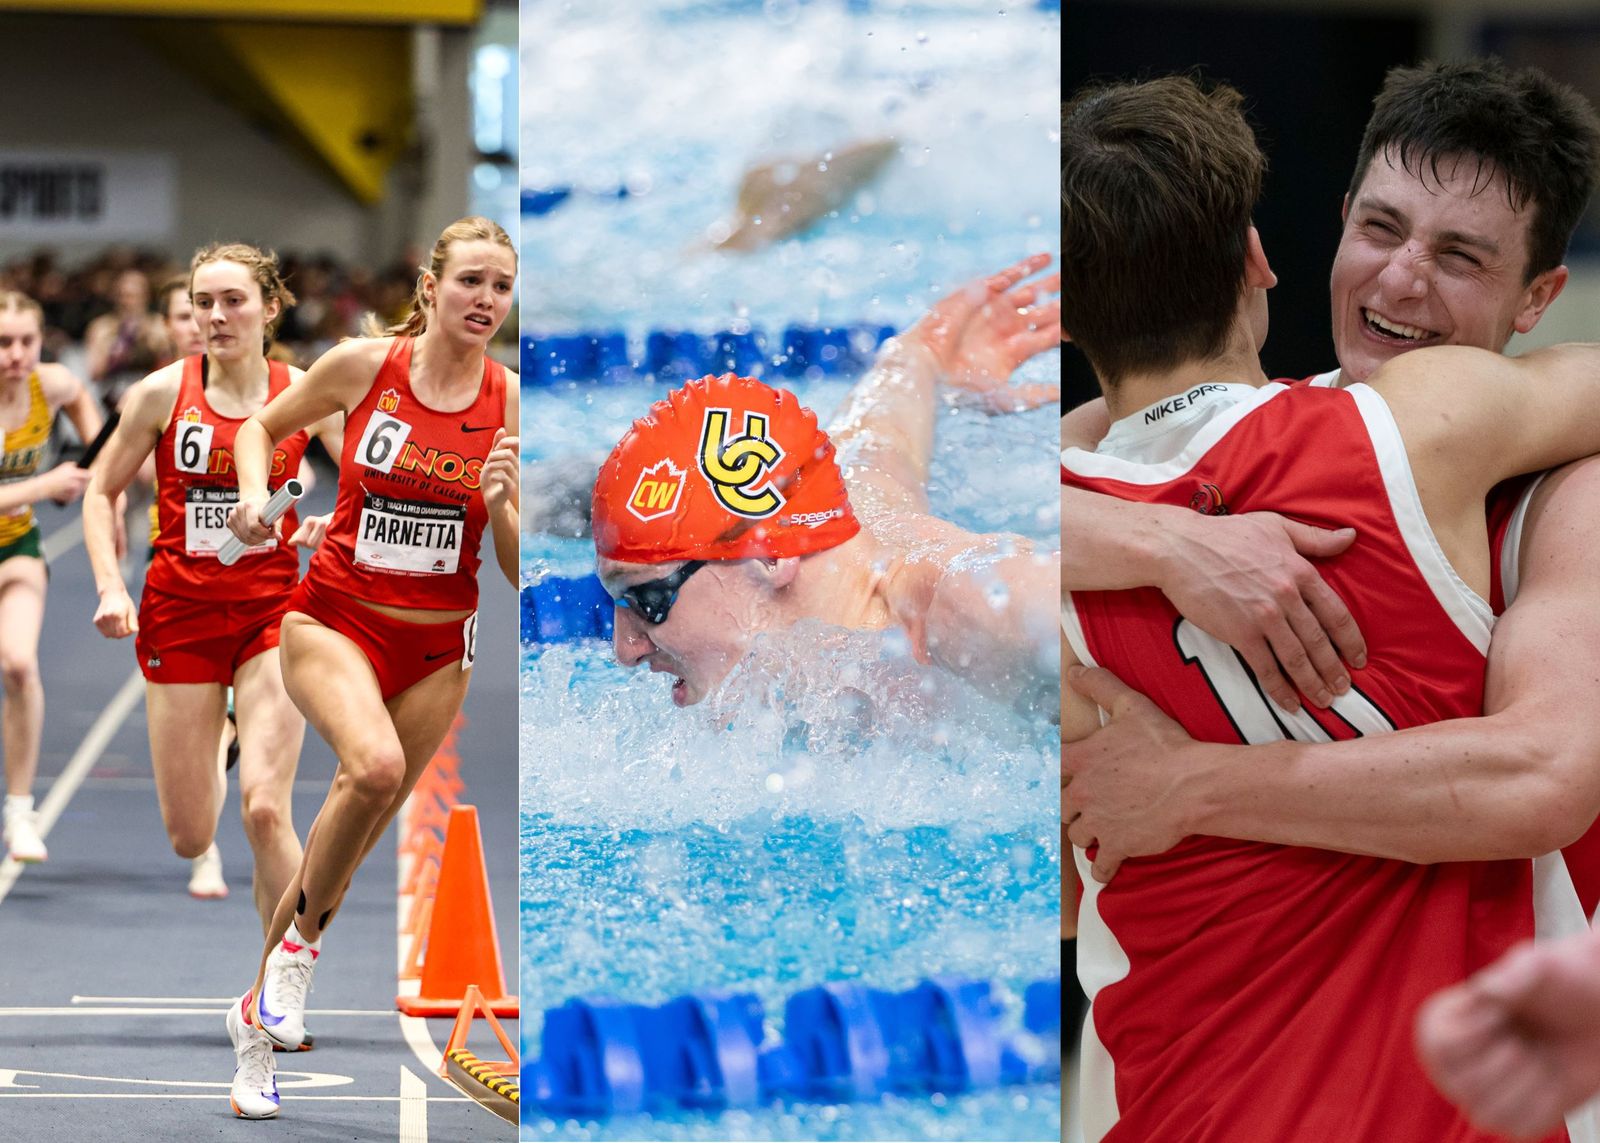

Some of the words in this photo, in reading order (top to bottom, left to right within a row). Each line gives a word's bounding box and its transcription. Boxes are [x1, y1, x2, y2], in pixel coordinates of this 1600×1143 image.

[379, 396, 398, 411] CW
[1144, 397, 1186, 425] NIKE
[1187, 384, 1228, 405] PRO
[180, 425, 204, 469] 6
[365, 419, 401, 466] 6
[392, 440, 485, 490] INOS
[364, 468, 417, 487] UNIVERSITY
[419, 480, 430, 490] OF
[433, 484, 472, 503] CALGARY
[633, 480, 677, 509] CW
[363, 513, 456, 550] PARNETTA
